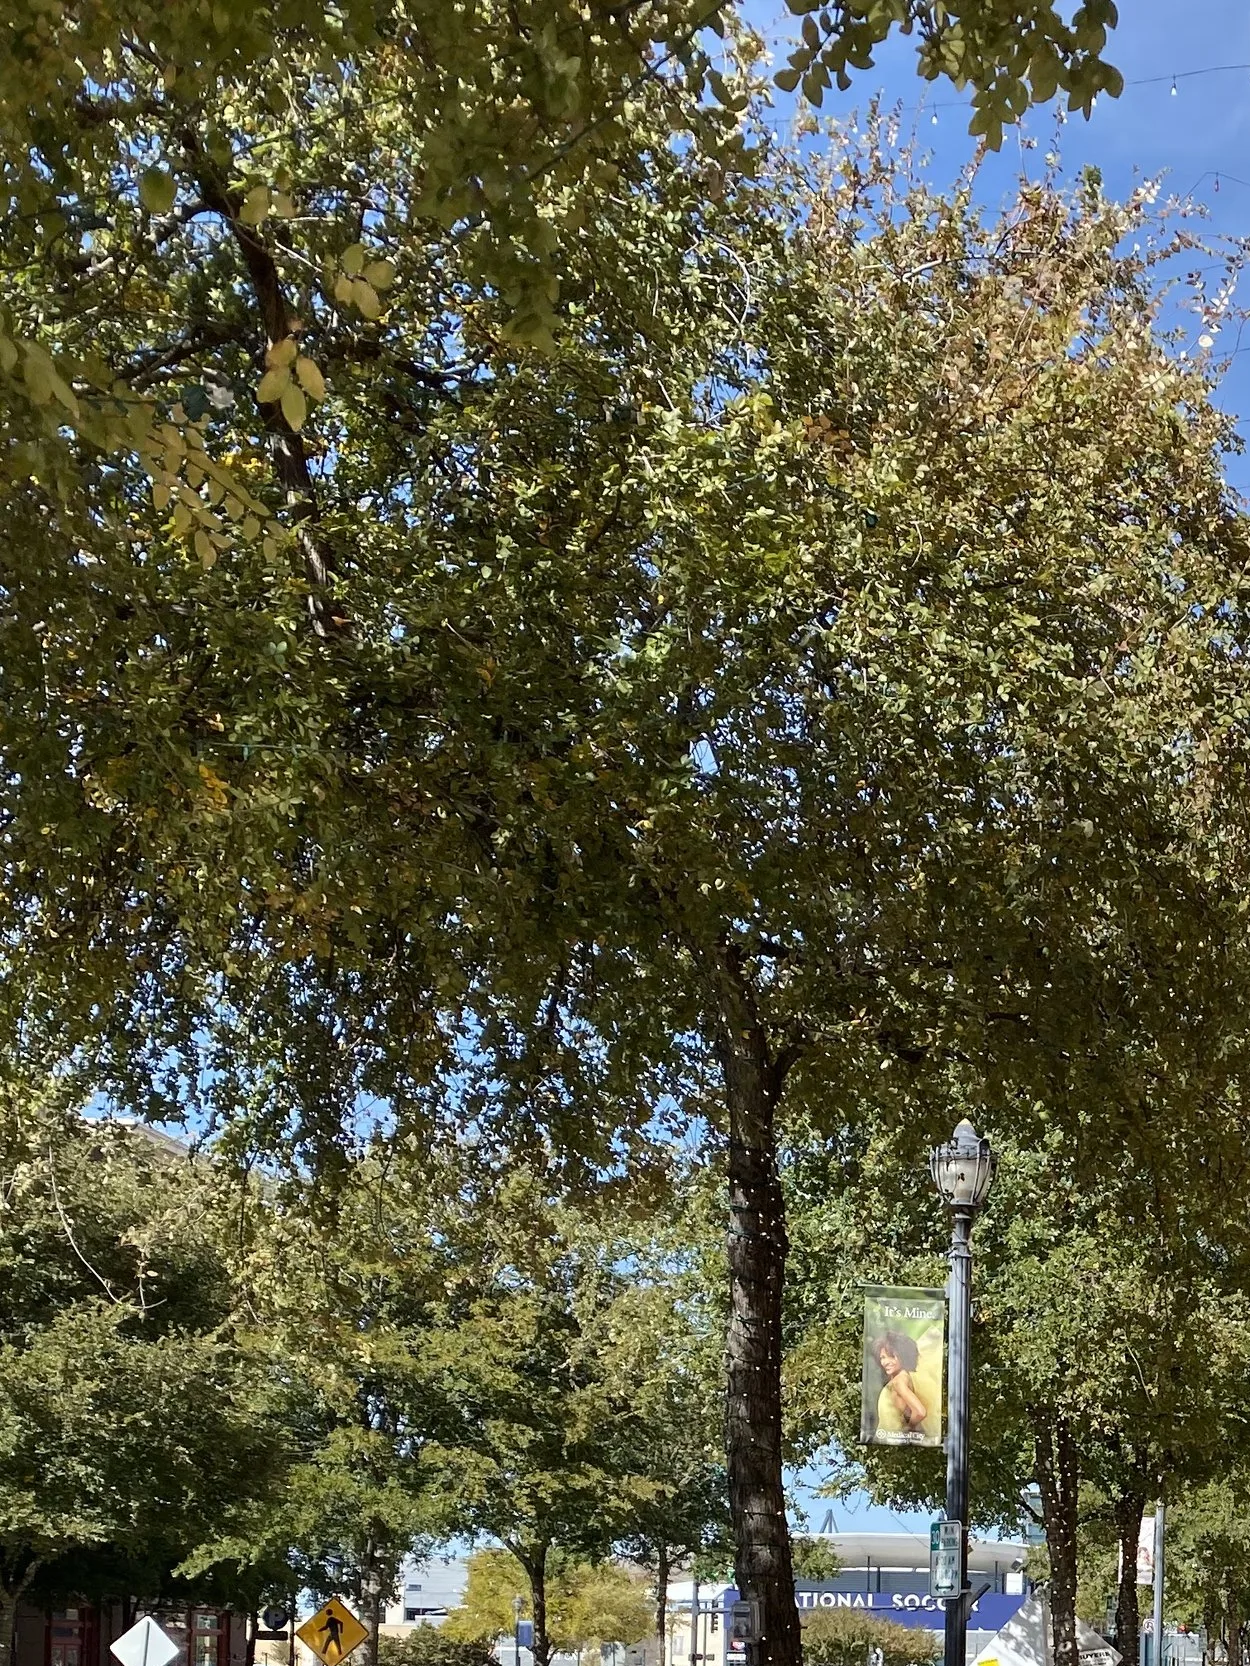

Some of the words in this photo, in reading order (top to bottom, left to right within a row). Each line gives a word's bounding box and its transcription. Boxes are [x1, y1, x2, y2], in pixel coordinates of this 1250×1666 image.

[884, 1305, 902, 1317] It's
[903, 1306, 936, 1319] Mine.
[887, 1431, 912, 1439] Medical
[912, 1431, 926, 1441] City
[931, 1529, 940, 1545] 30
[892, 1593, 979, 1612] SOCC
